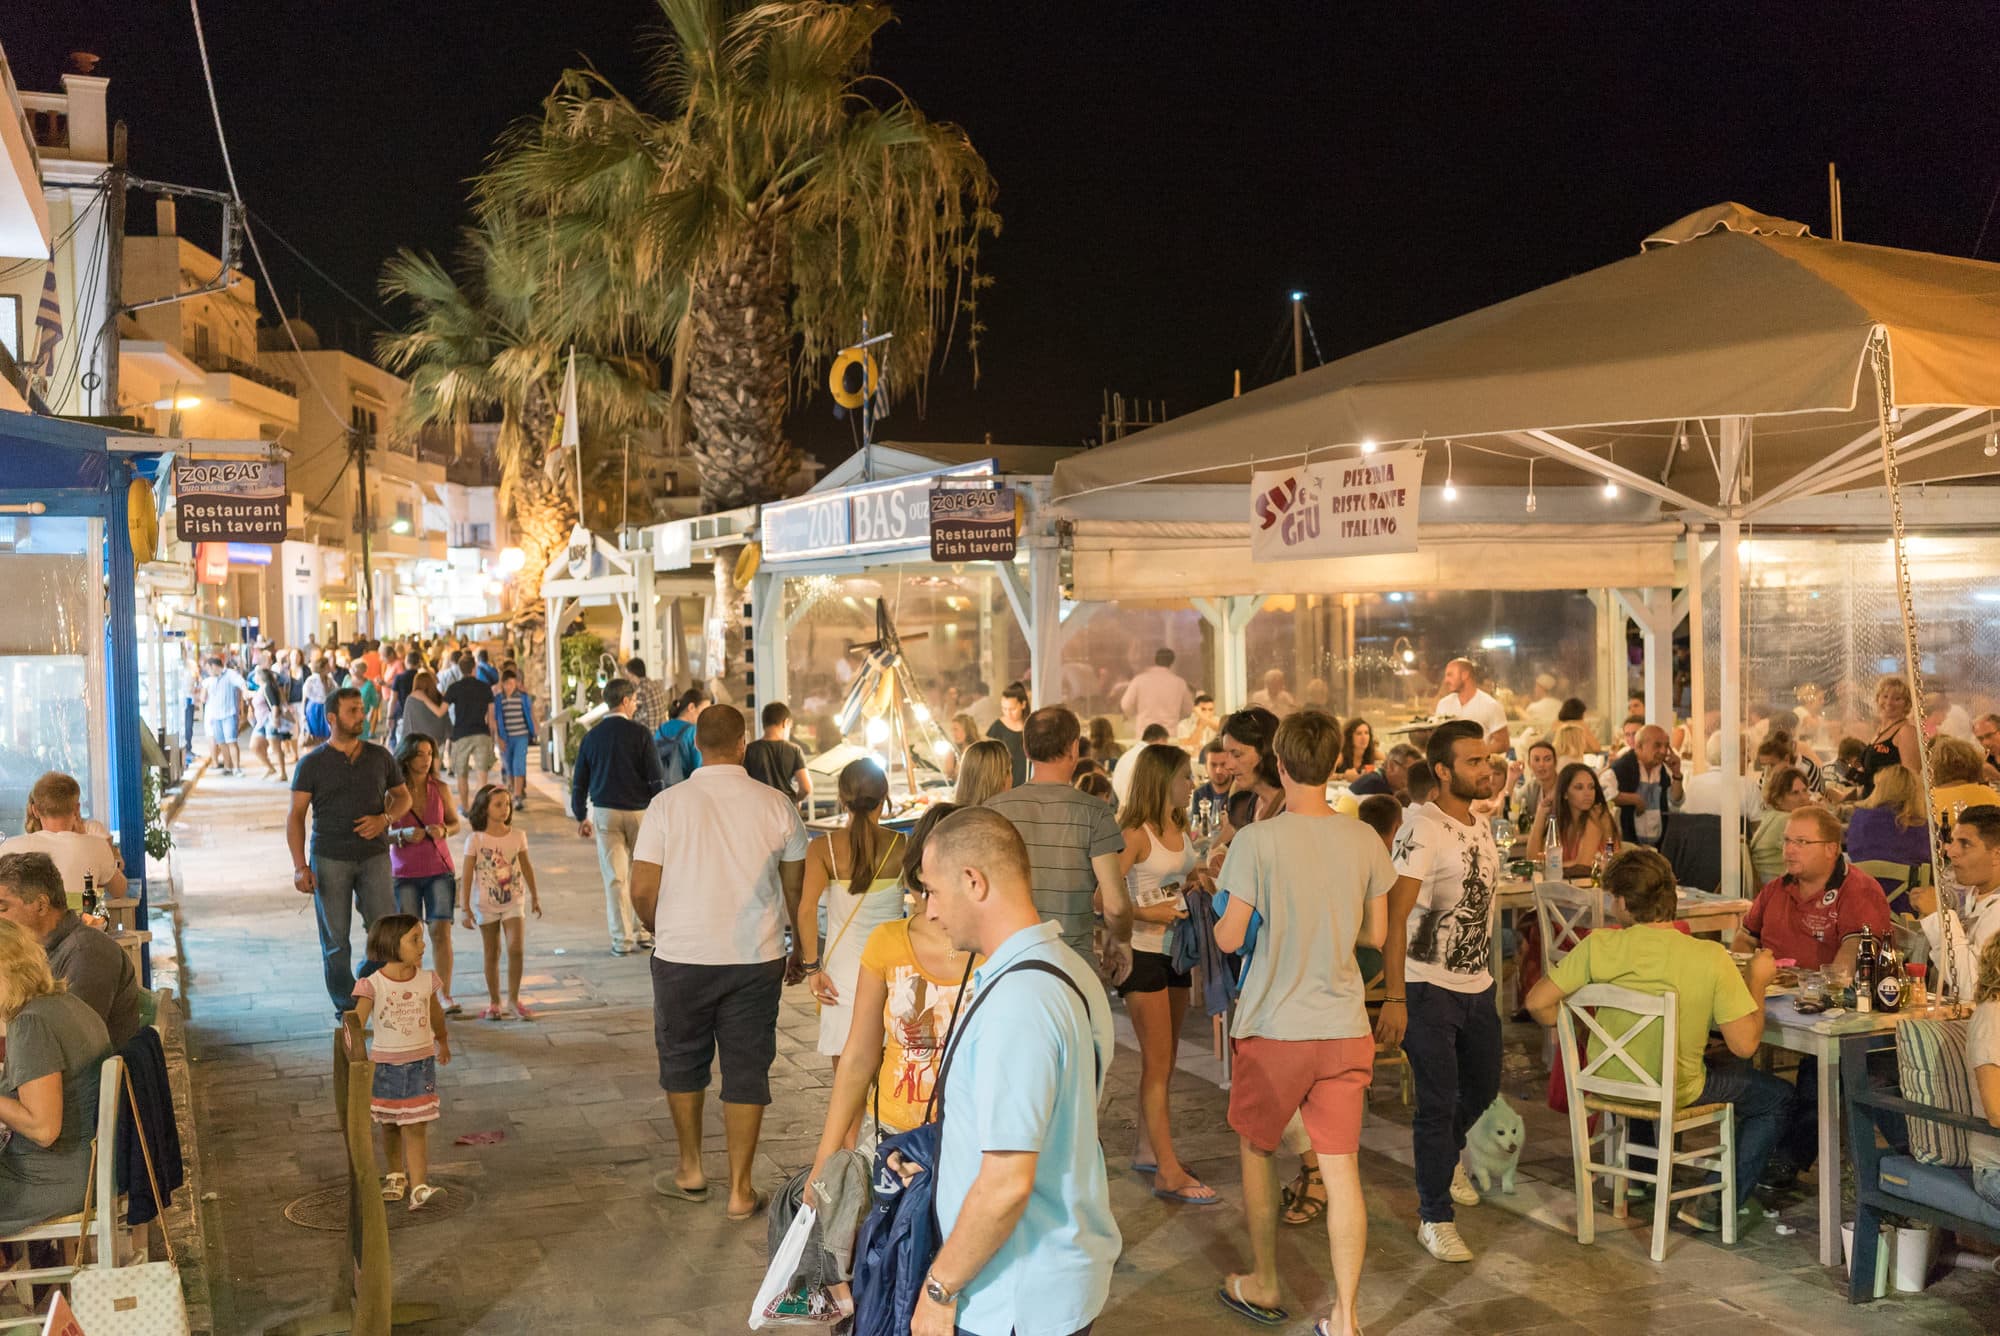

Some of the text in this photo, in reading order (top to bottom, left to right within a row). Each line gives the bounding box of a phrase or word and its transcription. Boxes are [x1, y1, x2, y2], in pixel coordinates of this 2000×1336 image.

[178, 462, 262, 486] ZORBAS
[183, 503, 281, 518] Restaurant
[909, 500, 930, 521] OUZ
[931, 491, 997, 513] ZORBAS
[184, 520, 282, 533] Fish tavern
[935, 526, 1012, 541] Restaurant
[1342, 516, 1397, 538] ITALIANO
[936, 542, 1013, 555] Fish tavern
